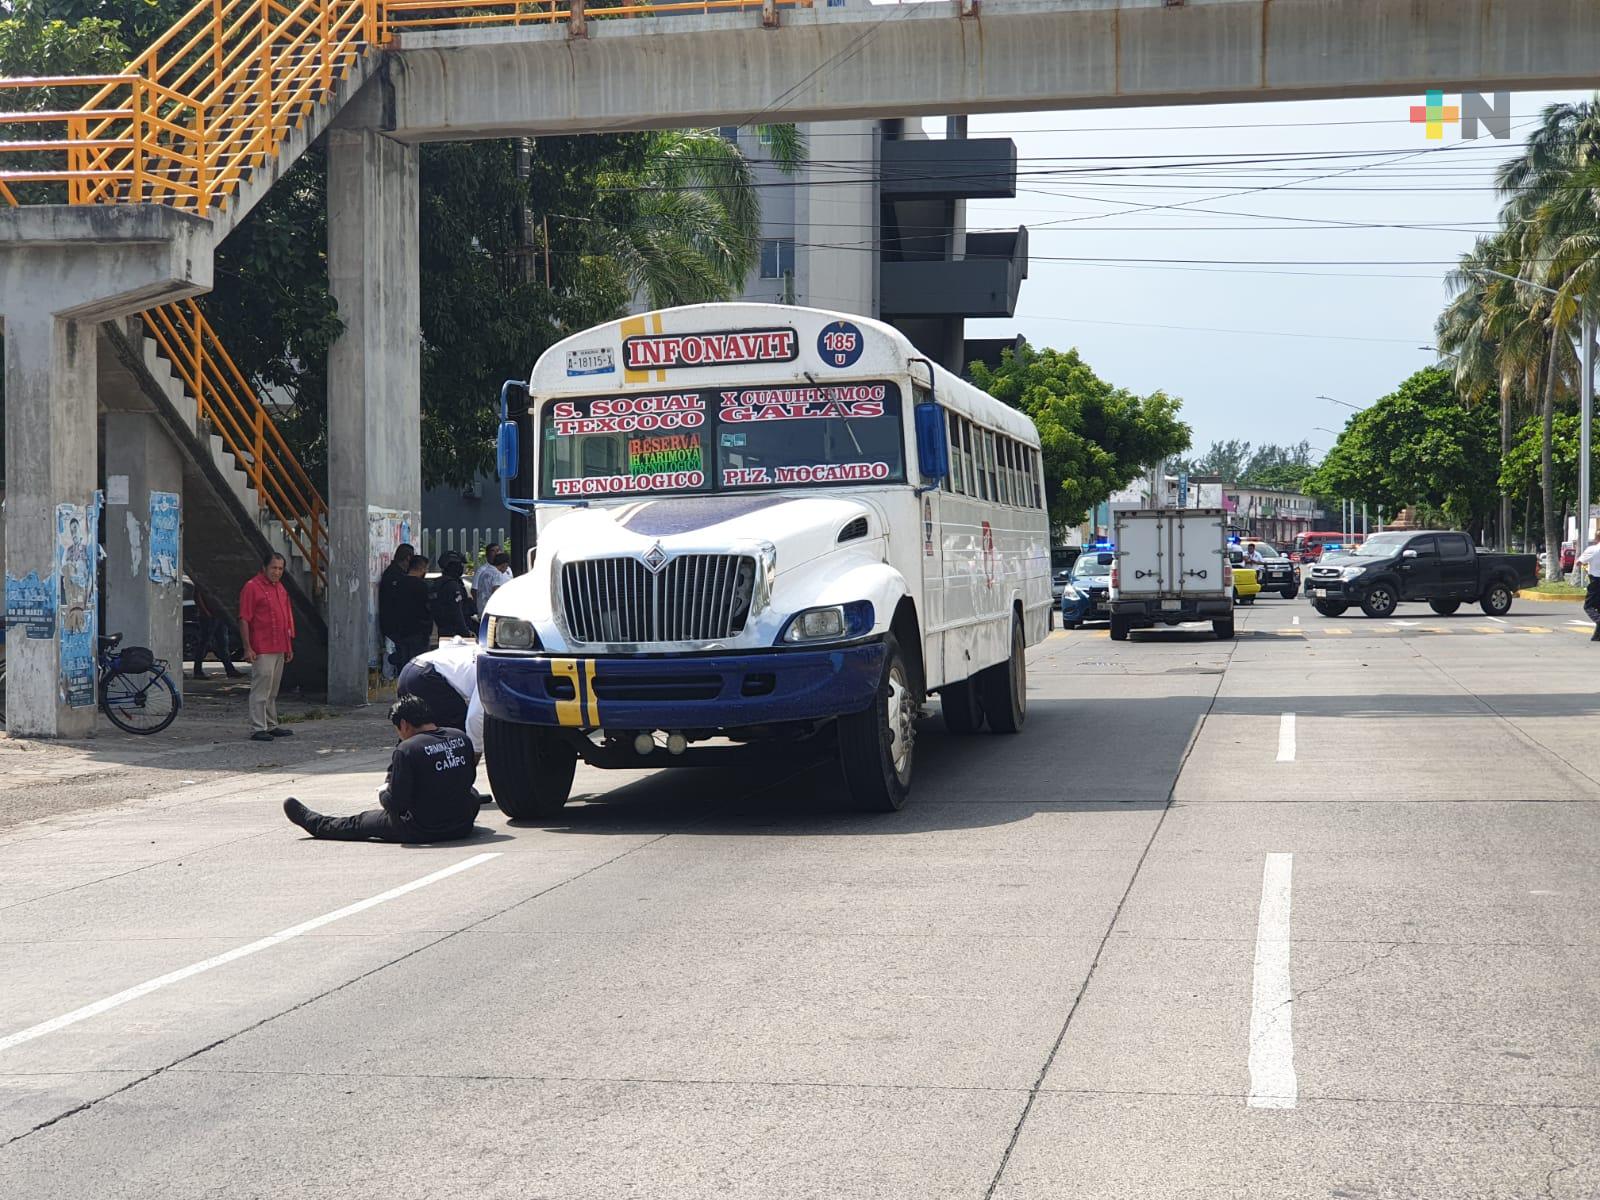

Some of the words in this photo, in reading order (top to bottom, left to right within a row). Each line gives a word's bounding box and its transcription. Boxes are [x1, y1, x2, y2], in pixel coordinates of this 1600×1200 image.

[628, 331, 791, 368] INFONAVIT
[823, 332, 856, 351] 185
[568, 355, 612, 368] A-18115-X
[835, 353, 847, 365] U
[553, 402, 583, 419] S.
[590, 394, 706, 416] SOCIAL
[720, 391, 738, 407] X
[740, 385, 885, 405] CUAUHTEMOC
[718, 402, 885, 423] GALAS
[554, 411, 705, 436] TEXCOCO
[630, 433, 700, 454] RESERVA
[631, 459, 701, 475] TECNOLOGICO
[723, 467, 771, 486] PLZ.
[775, 461, 890, 482] MOCAMBO
[553, 471, 704, 495] TECNOLOGICO
[435, 756, 466, 771] CAMPO
[445, 748, 455, 759] DE
